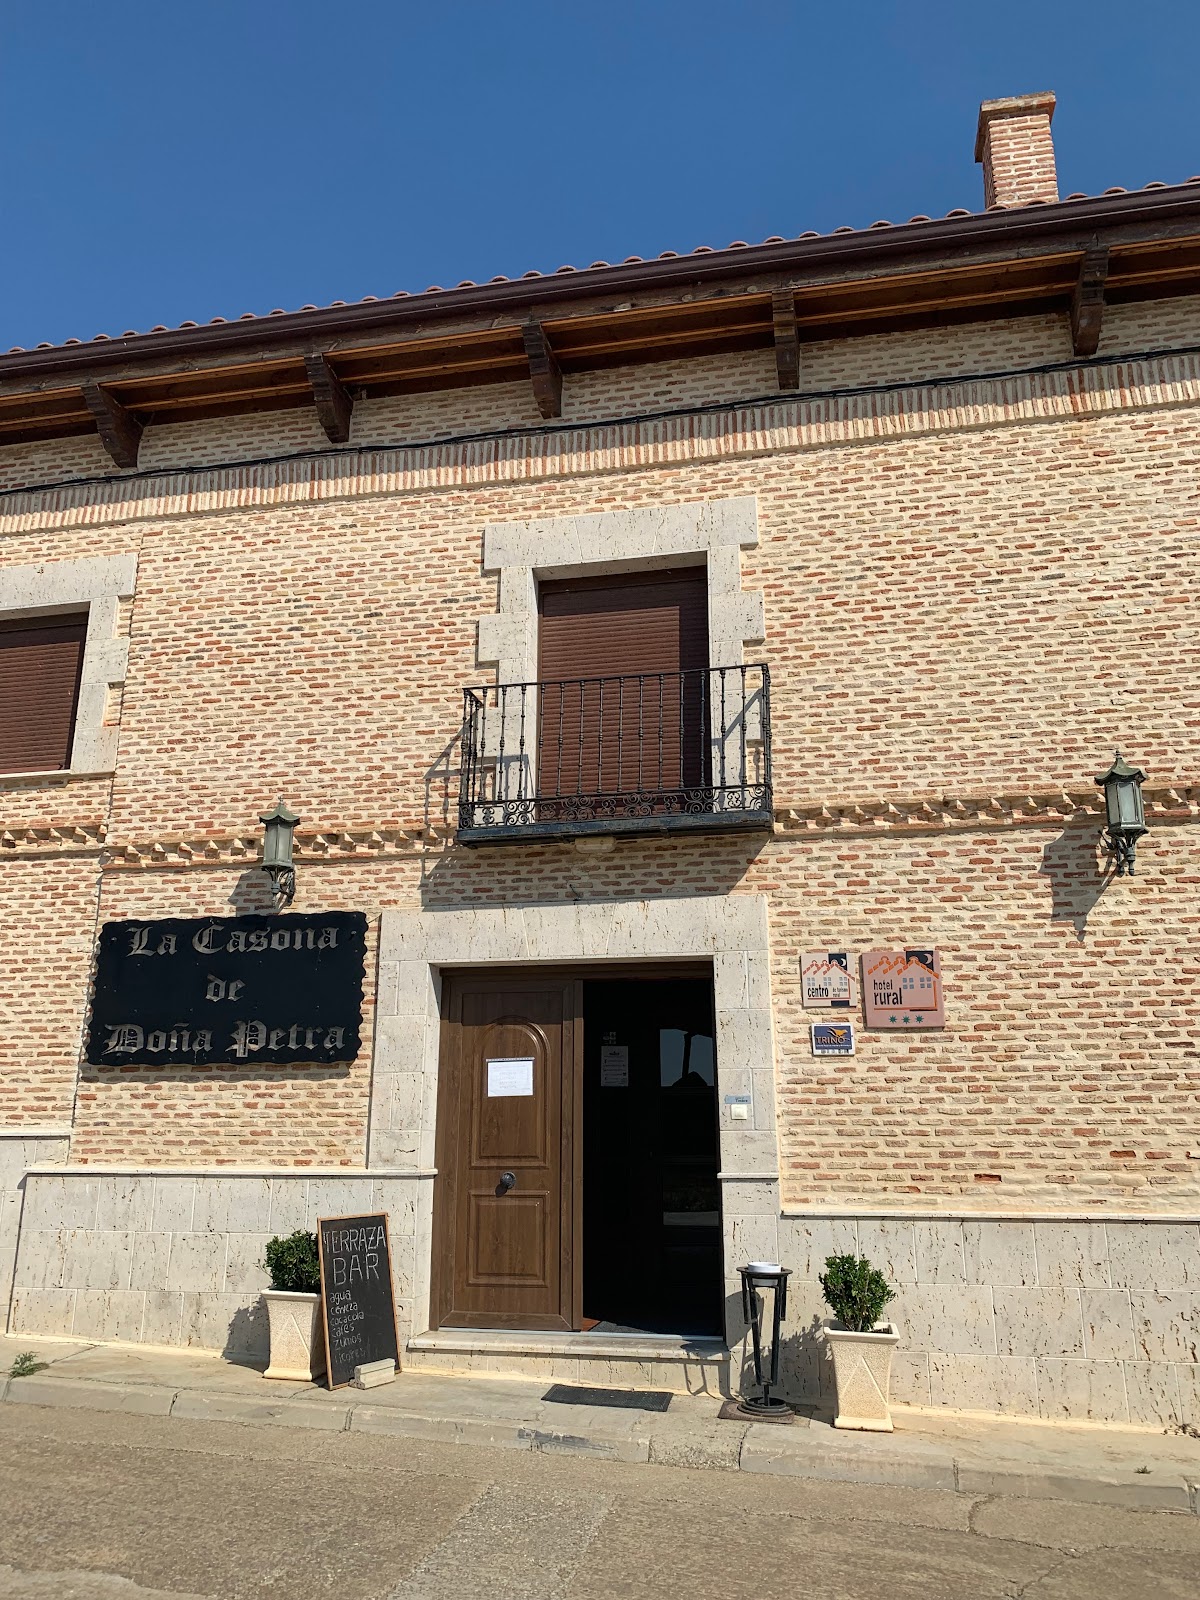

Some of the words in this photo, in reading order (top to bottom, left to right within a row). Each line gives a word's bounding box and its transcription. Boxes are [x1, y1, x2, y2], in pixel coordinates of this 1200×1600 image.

[126, 926, 177, 957] La
[192, 925, 339, 954] Casona
[205, 973, 246, 1002] de
[808, 984, 829, 997] centro
[873, 979, 893, 990] hotel
[873, 987, 903, 1006] rural
[101, 1023, 213, 1055] Doña
[225, 1020, 345, 1058] Petra
[323, 1225, 387, 1254] TERRAZA
[332, 1252, 380, 1286] BAR
[330, 1289, 352, 1305] agua
[330, 1301, 358, 1316] cerveza
[330, 1311, 365, 1326] cocacola
